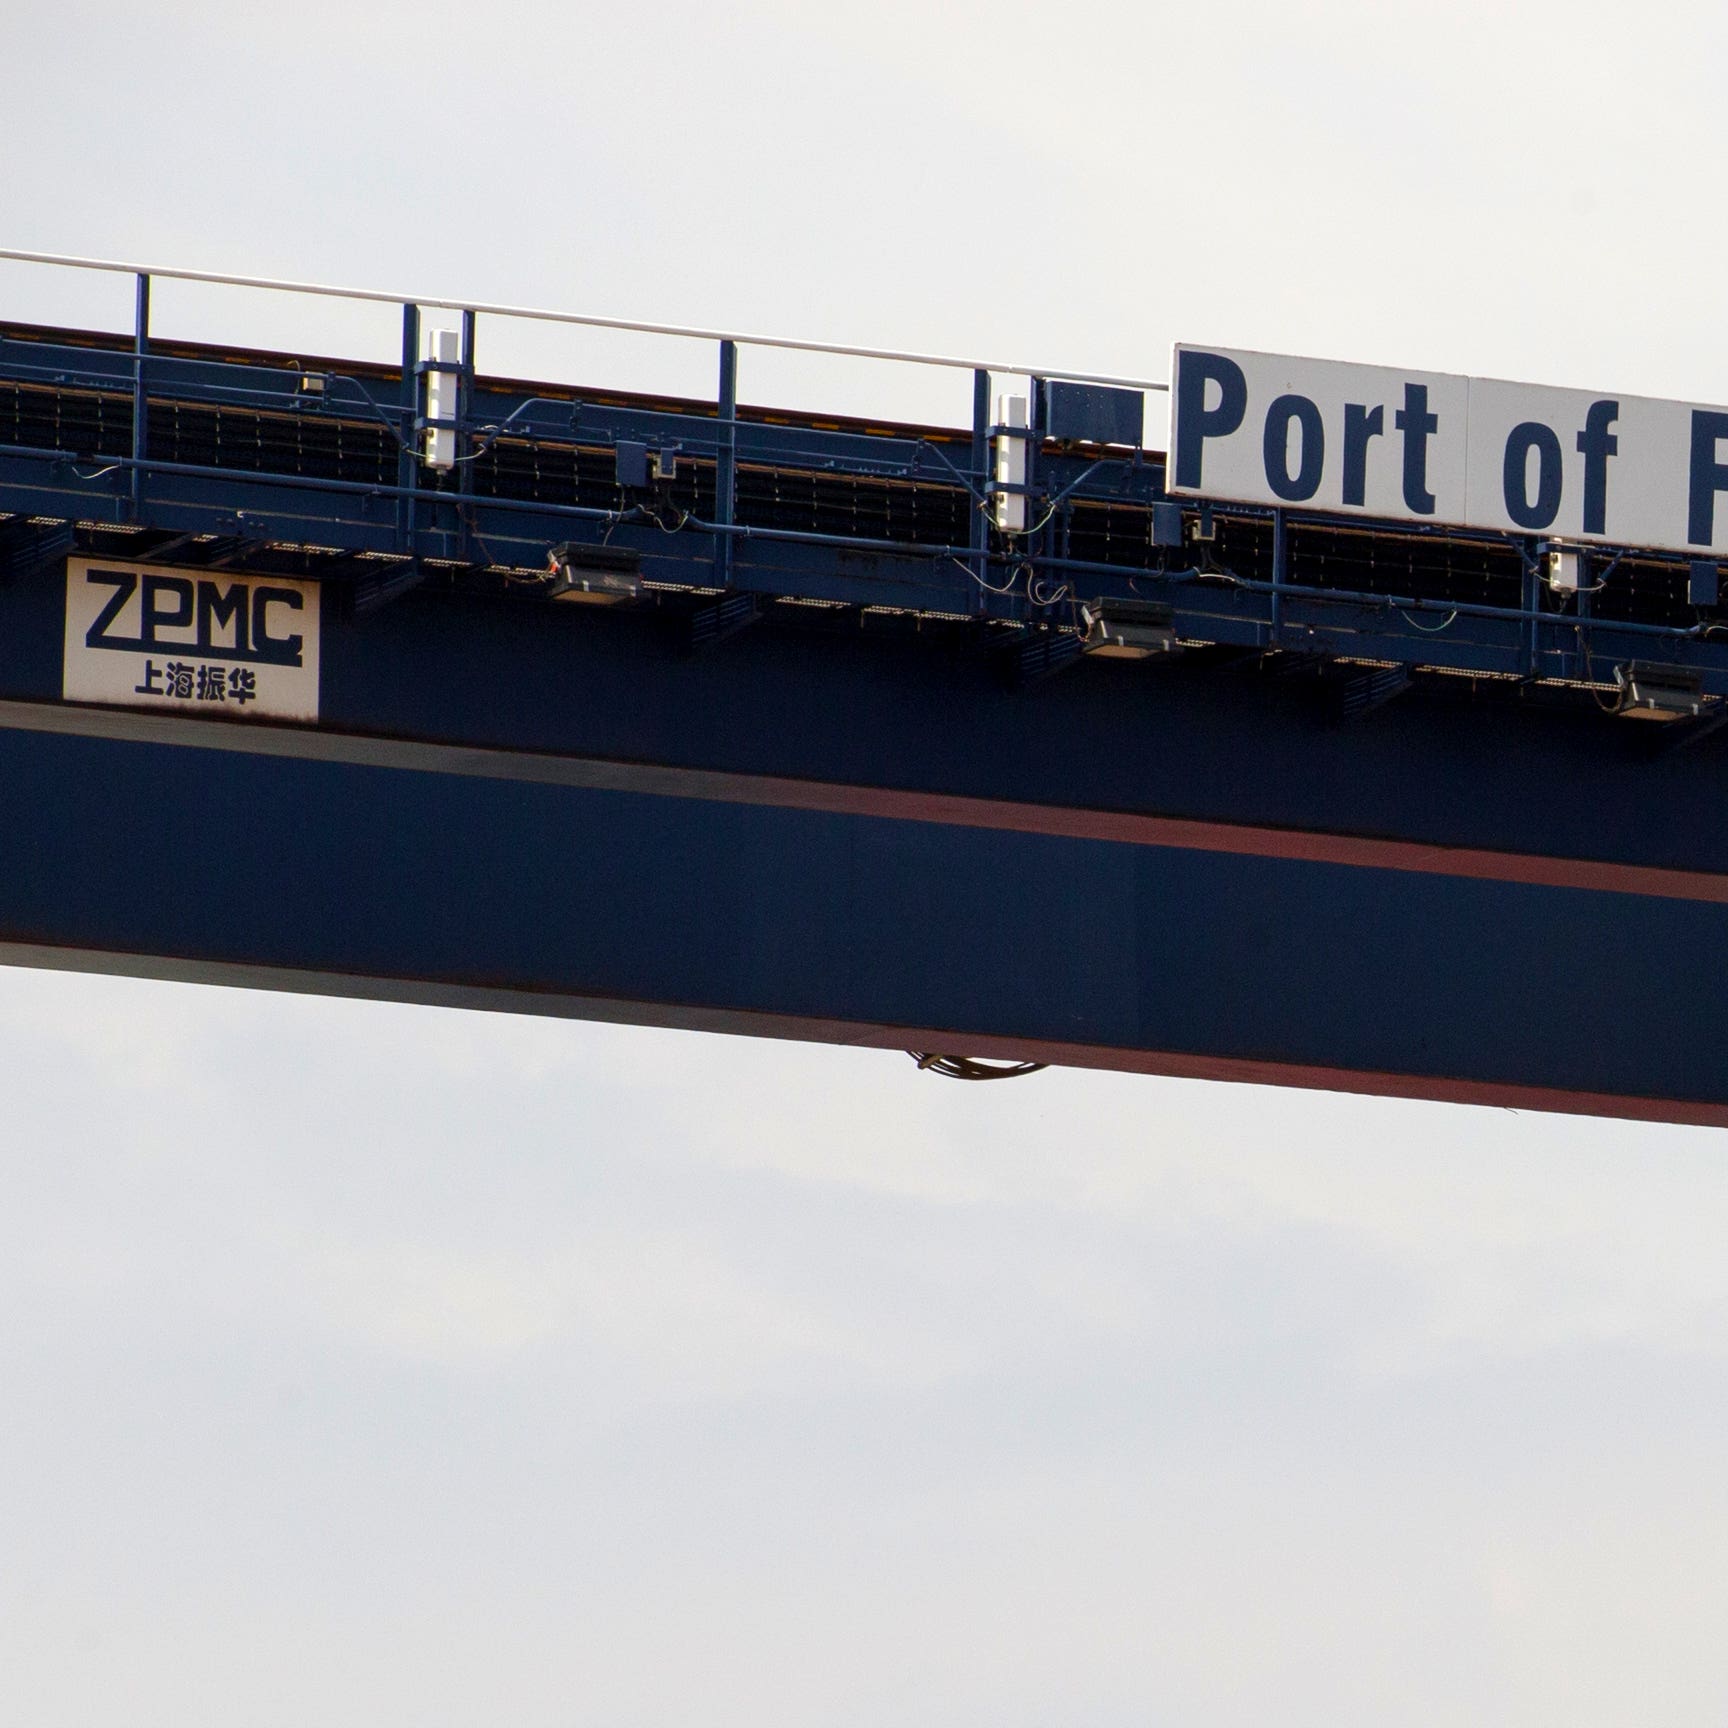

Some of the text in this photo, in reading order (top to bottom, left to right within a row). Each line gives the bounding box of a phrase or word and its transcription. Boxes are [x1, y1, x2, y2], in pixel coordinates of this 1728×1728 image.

[1173, 350, 1437, 515] Port
[1502, 399, 1619, 534] of
[86, 568, 304, 668] ZPMC
[135, 659, 256, 704] 上海振华
